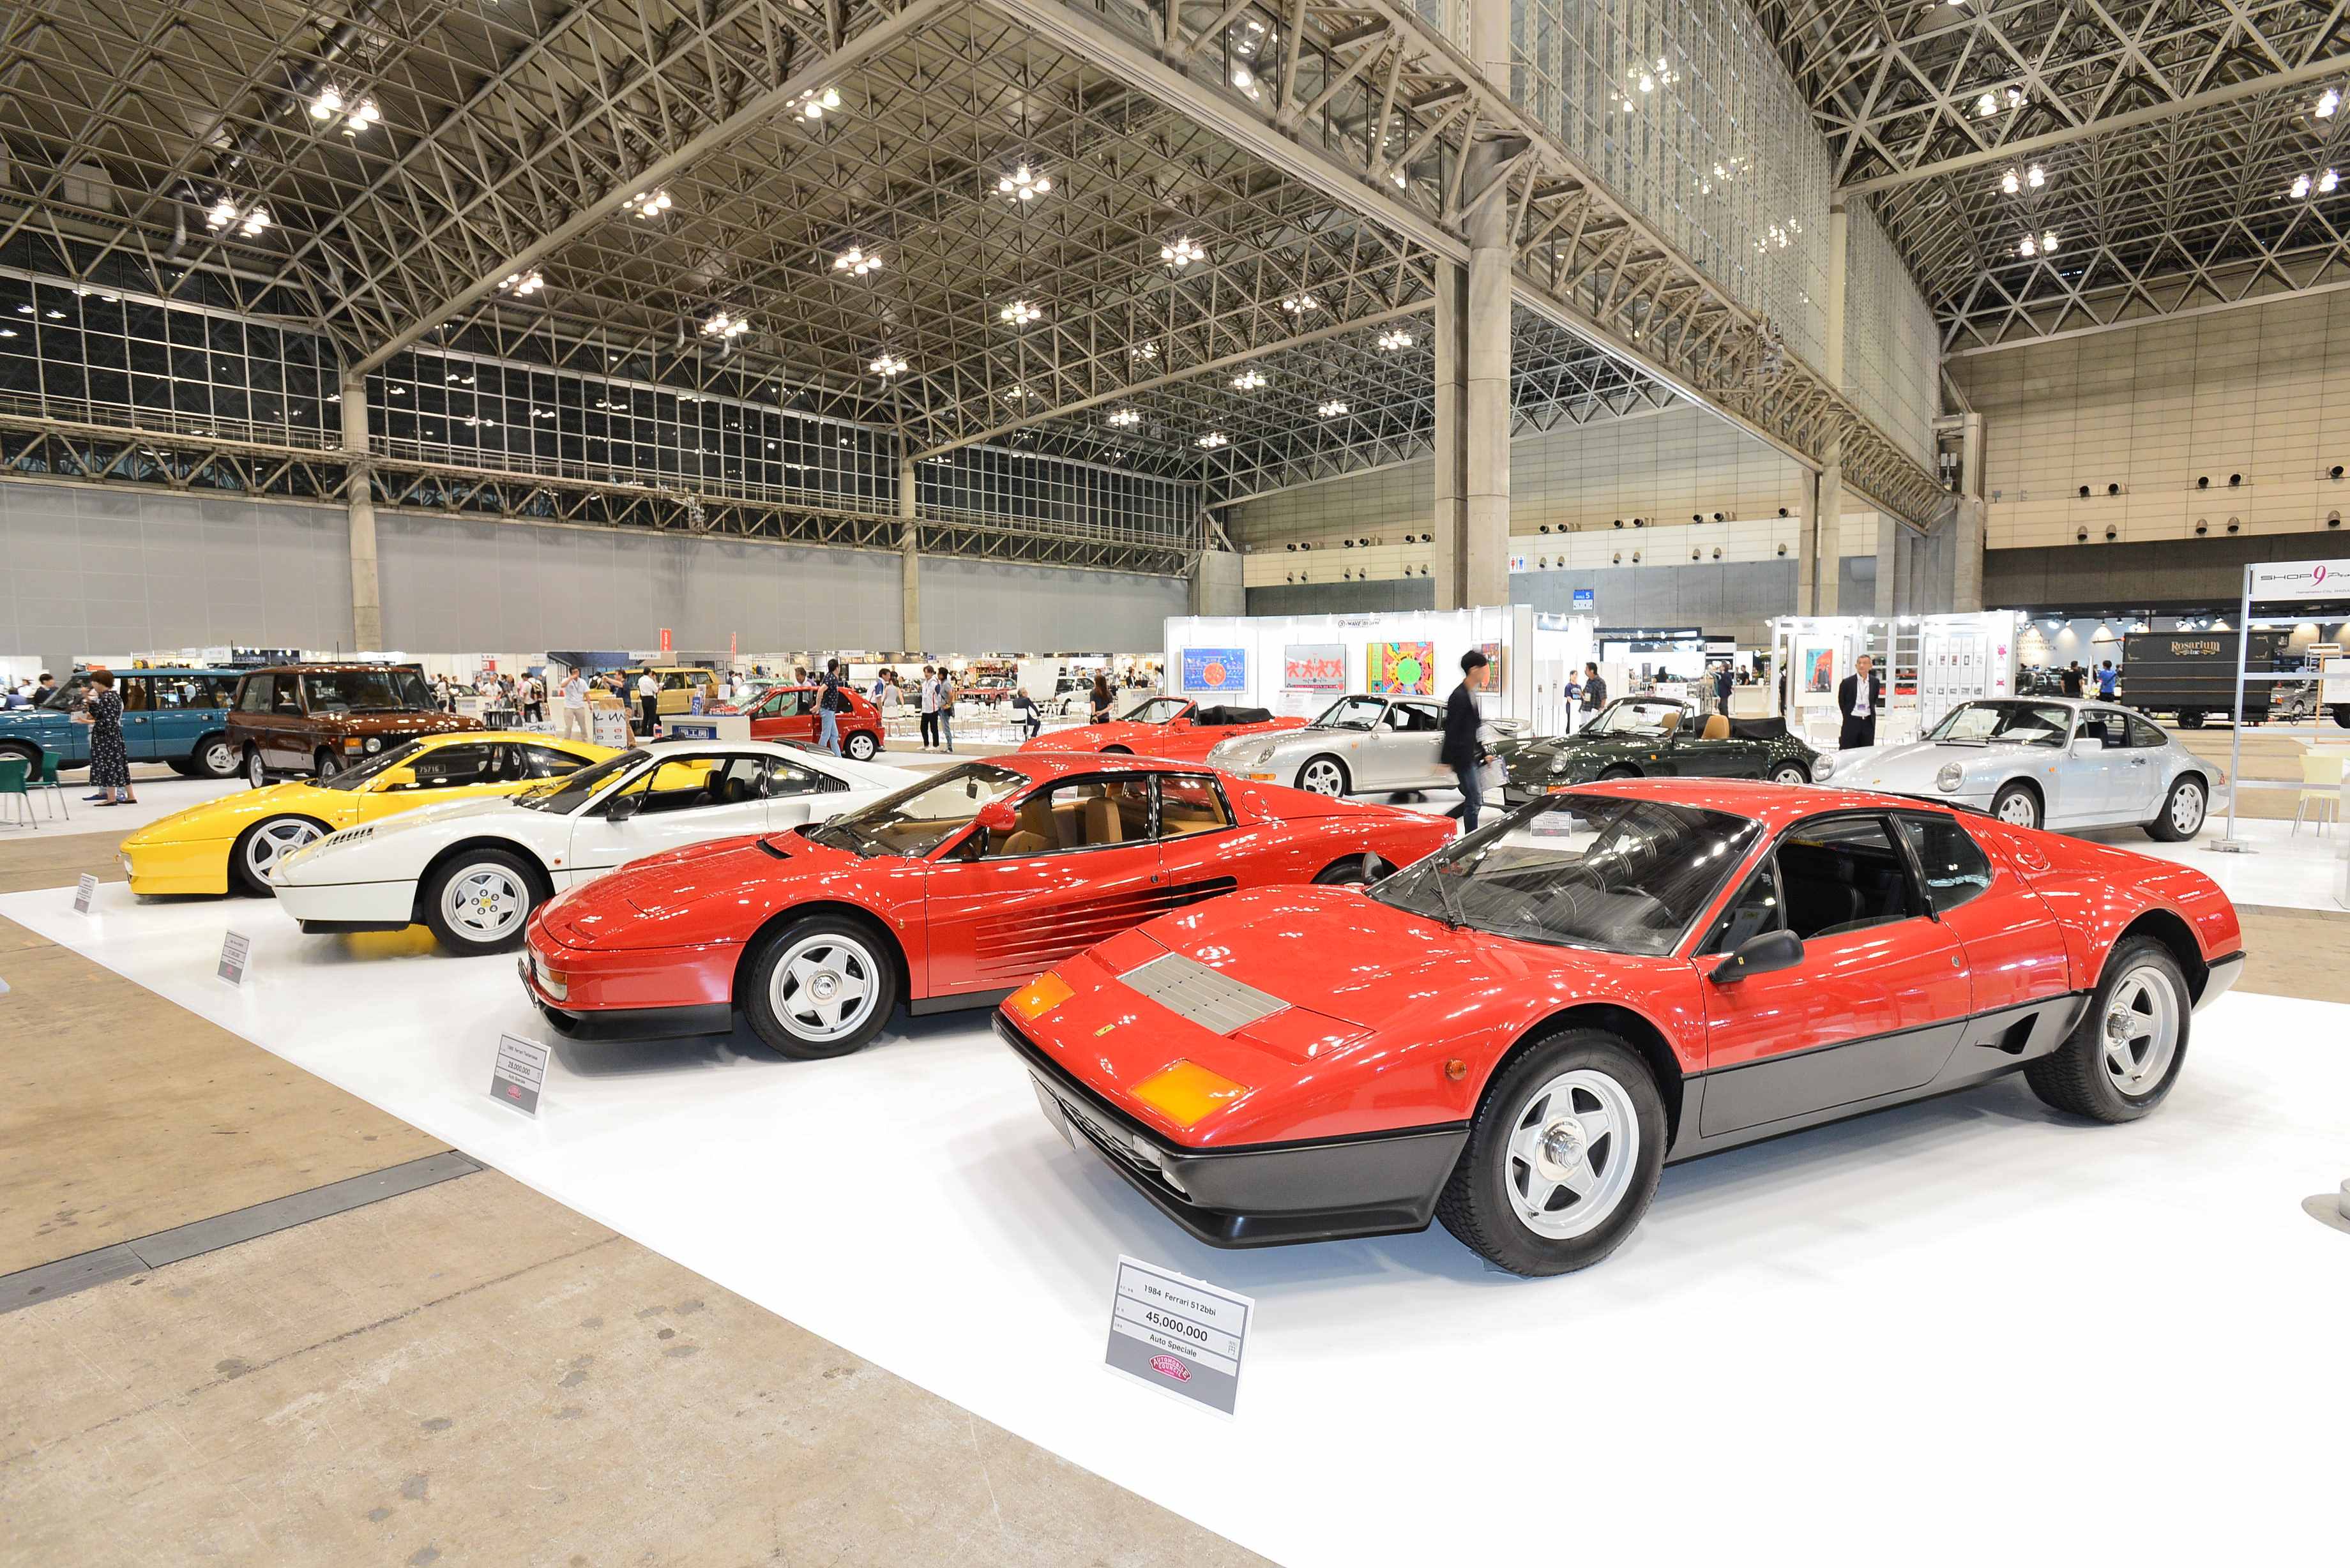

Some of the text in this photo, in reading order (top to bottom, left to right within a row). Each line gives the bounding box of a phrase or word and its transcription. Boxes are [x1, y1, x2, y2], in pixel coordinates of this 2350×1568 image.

[2171, 641, 2220, 652] Rosarium
[1144, 1285, 1161, 1296] 1984
[1165, 1292, 1190, 1306] Ferrari
[1190, 1301, 1216, 1316] 512bbi
[1146, 1311, 1208, 1341] 45,000,000
[1149, 1334, 1197, 1357] Auto Speciale
[1153, 1357, 1188, 1378] AUTOMOBILE
